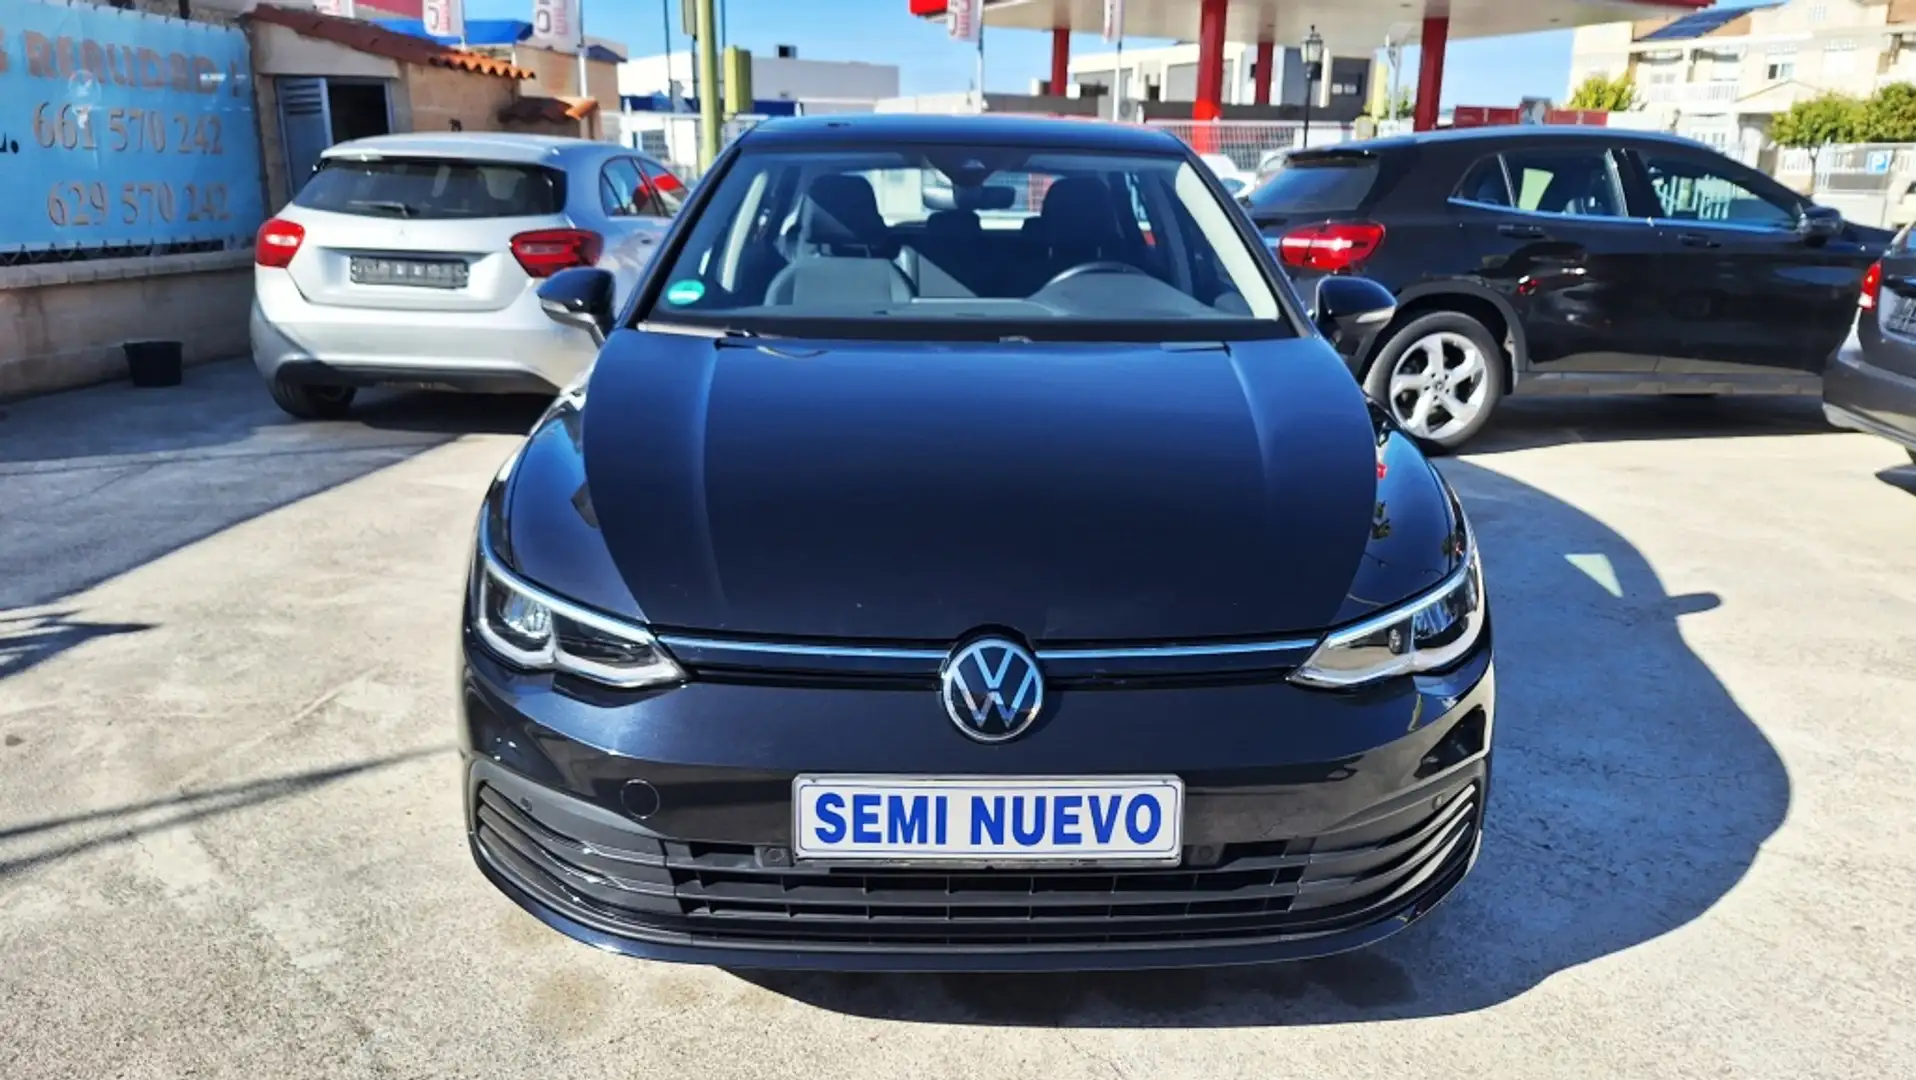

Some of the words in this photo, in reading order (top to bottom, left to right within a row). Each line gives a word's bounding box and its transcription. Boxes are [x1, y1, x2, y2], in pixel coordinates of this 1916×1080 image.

[33, 101, 98, 150] 661
[109, 107, 166, 153] 570
[173, 111, 223, 155] 242
[47, 181, 108, 227] 629
[121, 182, 175, 225] 570
[184, 182, 231, 222] 242
[815, 792, 947, 845] SEMI
[970, 793, 1161, 846] NUEVO
